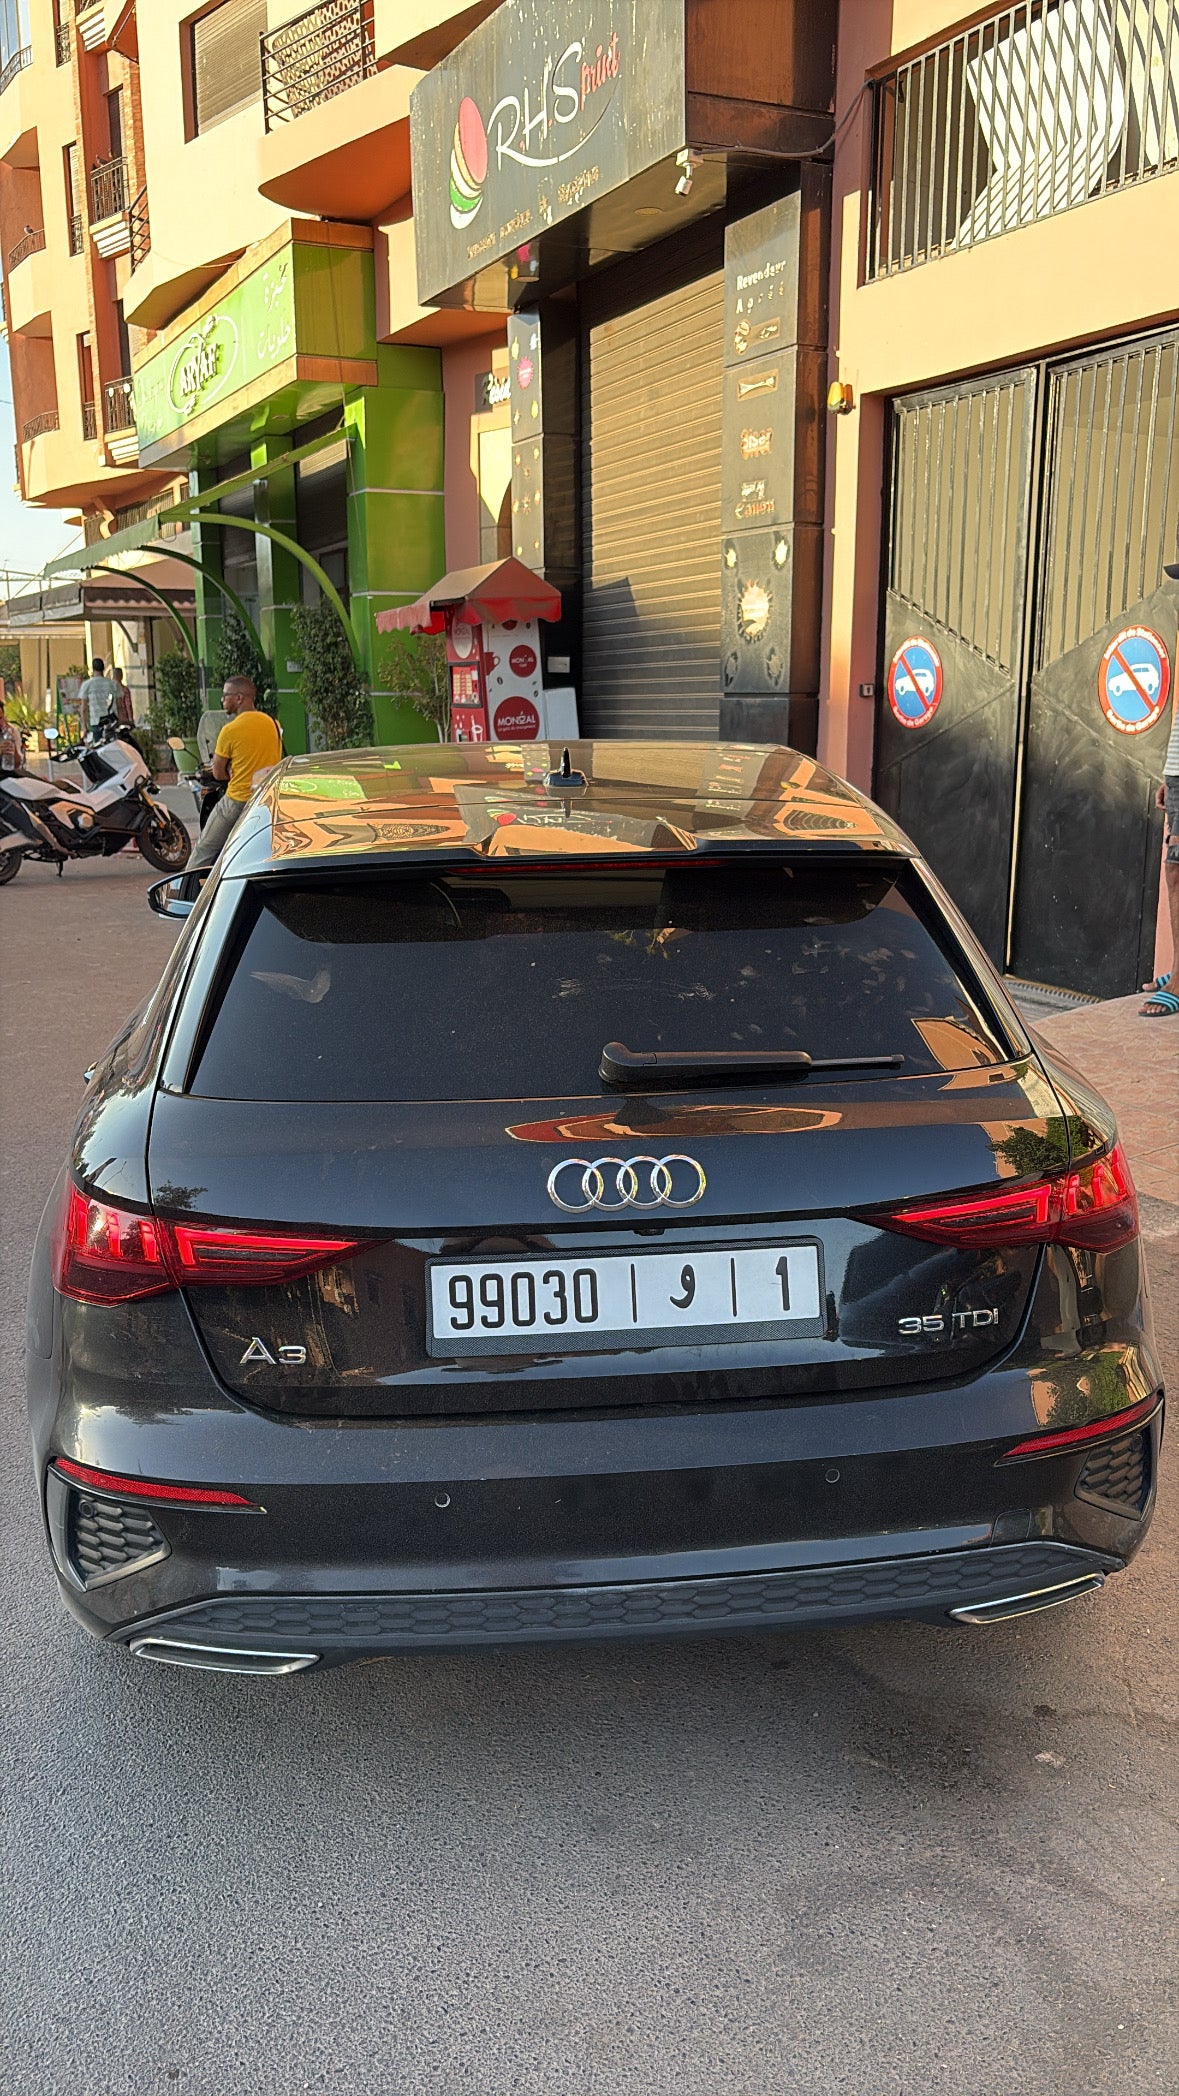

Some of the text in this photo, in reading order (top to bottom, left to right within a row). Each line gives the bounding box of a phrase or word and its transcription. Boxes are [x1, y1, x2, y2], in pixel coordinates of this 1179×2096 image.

[736, 260, 787, 291] Revendeur
[1125, 724, 1136, 732] de
[1135, 706, 1160, 731] Garage
[448, 1255, 791, 1331] 99030 و 1
[898, 1307, 999, 1335] 35 TDI
[239, 1336, 307, 1366] A3
